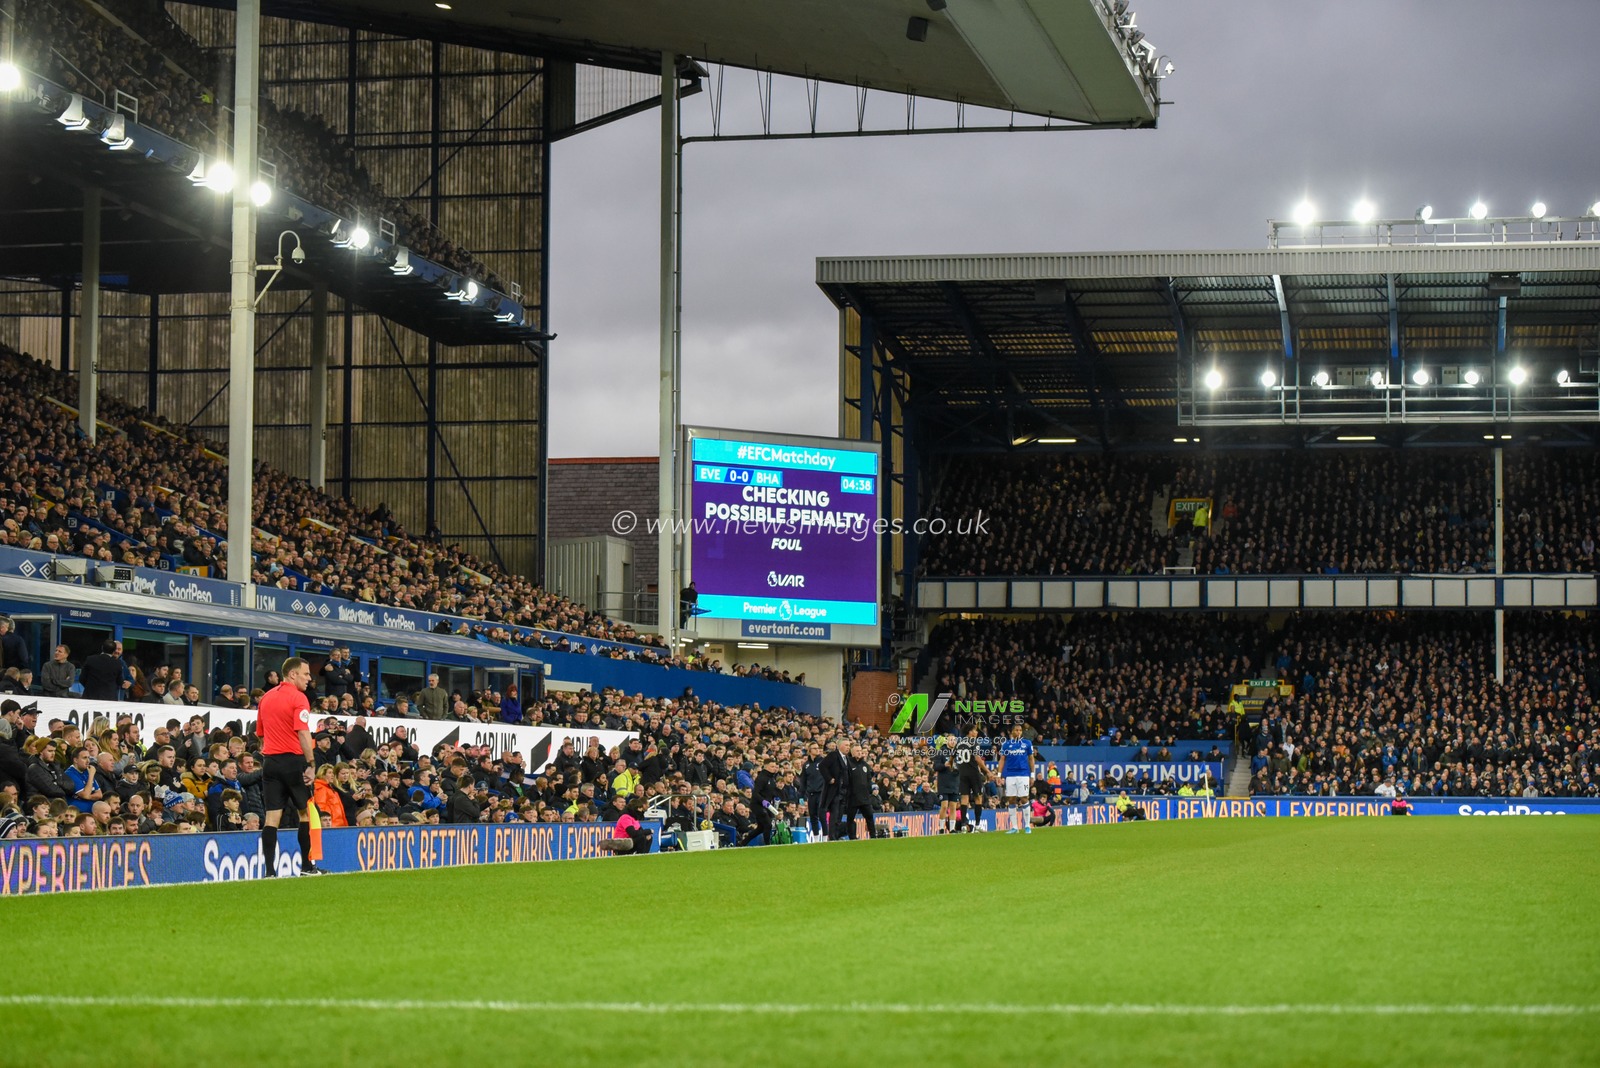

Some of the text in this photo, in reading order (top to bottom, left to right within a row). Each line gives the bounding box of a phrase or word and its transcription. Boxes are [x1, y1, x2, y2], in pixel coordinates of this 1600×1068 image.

[737, 445, 836, 469] #EFCMatchday
[701, 468, 780, 485] EVE 0-0 BHA
[842, 478, 871, 491] 04:38
[742, 485, 830, 507] CHECKING
[1175, 502, 1195, 511] EXIT
[705, 502, 866, 529] POSSIBLE PENALTY
[771, 537, 802, 551] FOUL
[778, 574, 805, 588] VAR
[256, 594, 276, 612] USM
[743, 602, 827, 618] Premier League
[748, 622, 825, 637] evertonfc.com
[1065, 764, 1103, 782] NISI
[1178, 801, 1266, 819] REWARDS
[1290, 801, 1414, 817] EXPERIENCS
[357, 829, 414, 872] SPORTS
[420, 828, 479, 869] BETTING
[495, 826, 554, 863] REWARDS
